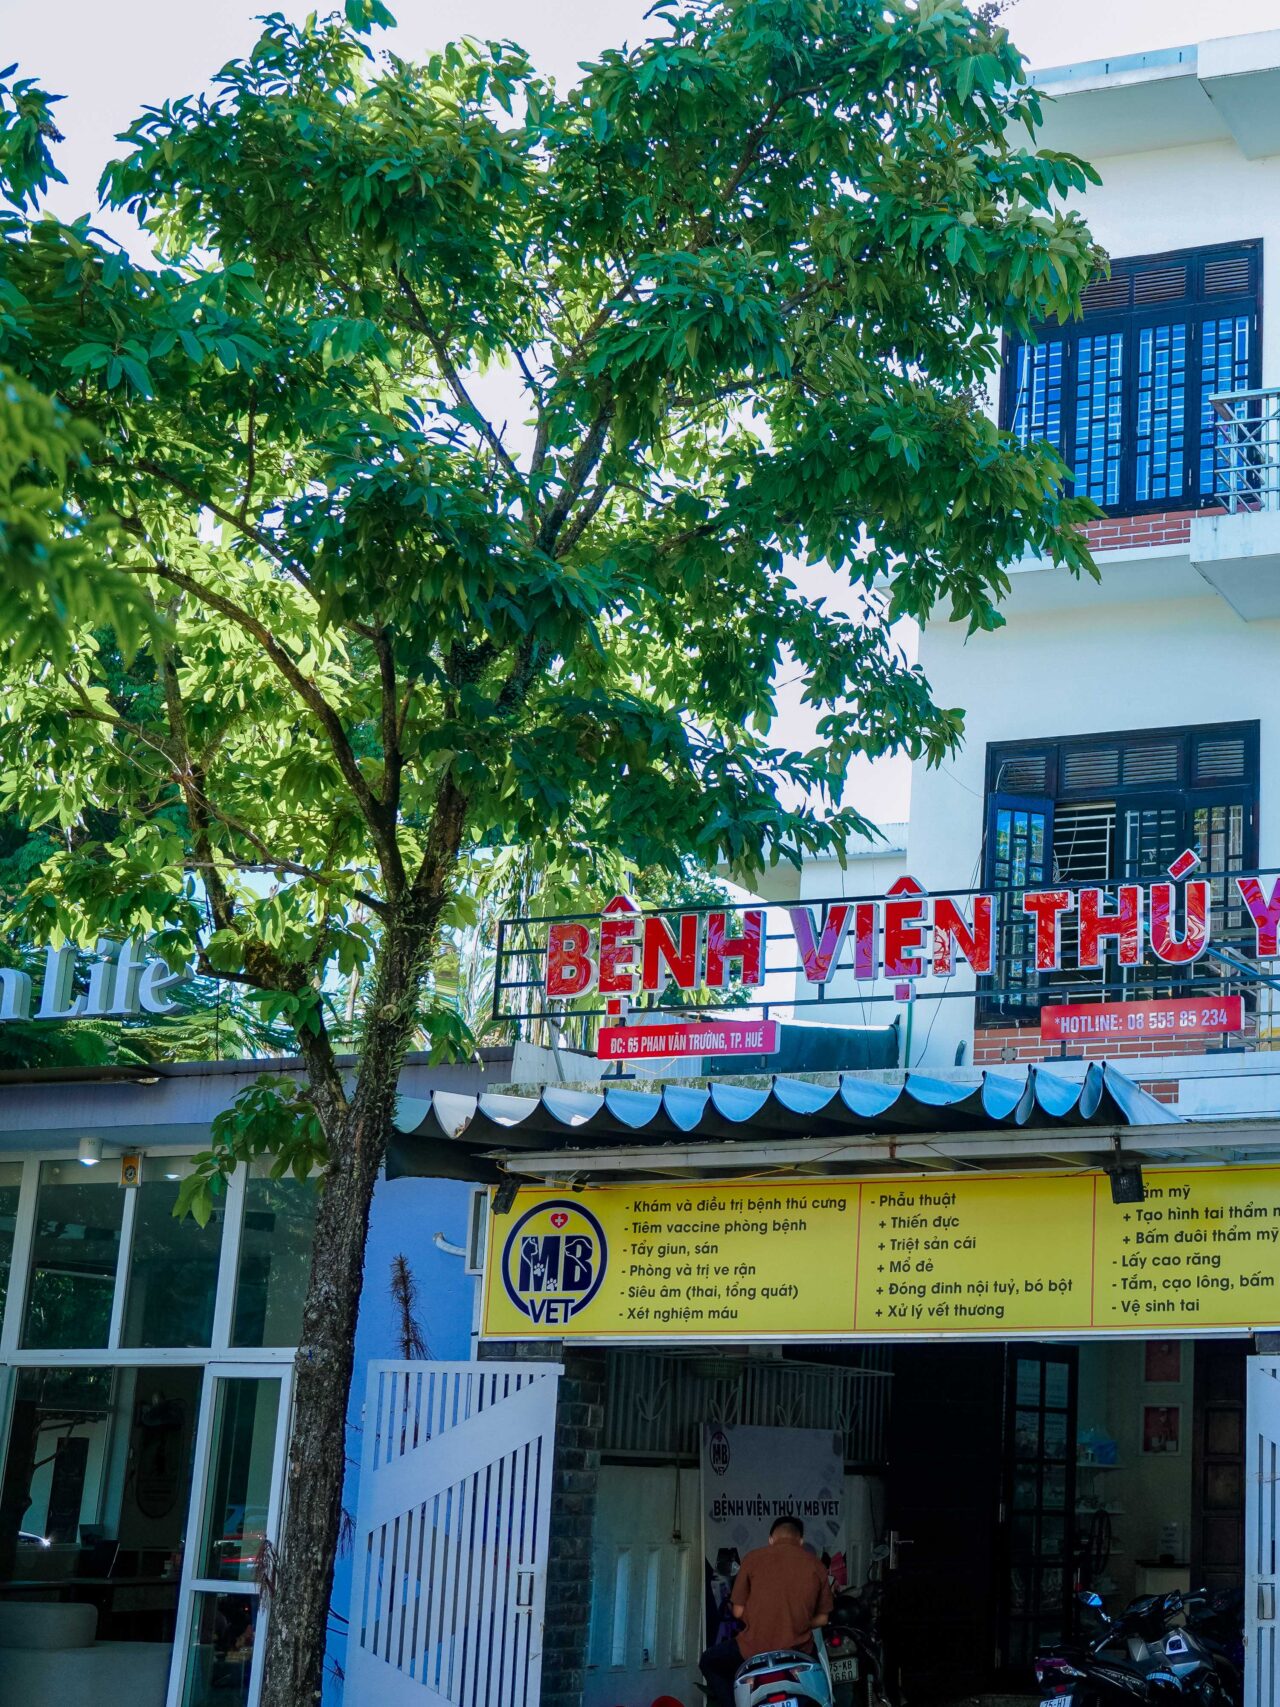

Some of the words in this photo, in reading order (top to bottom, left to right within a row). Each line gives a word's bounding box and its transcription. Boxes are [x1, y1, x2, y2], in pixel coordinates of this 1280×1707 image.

[545, 895, 767, 1017] BỆNH
[788, 875, 997, 1003] VIỆN
[1022, 848, 1211, 972] THÚ
[1127, 1013, 1145, 1030] 08
[1148, 1011, 1175, 1029] 555
[1179, 1010, 1197, 1027] 85
[1201, 1008, 1228, 1026] 234
[627, 1037, 639, 1053] 65
[640, 1035, 666, 1052] PHAN
[668, 1031, 687, 1051] VĂN
[730, 1032, 743, 1049] TP.
[745, 1025, 765, 1048] HUẾ
[879, 1191, 915, 1207] Phẫu
[918, 1191, 957, 1209] thuật
[1168, 1184, 1191, 1201] mỹ
[633, 1199, 672, 1213] Khám
[676, 1198, 693, 1212] và
[696, 1195, 726, 1212] điều
[730, 1198, 744, 1214] trị
[747, 1197, 782, 1214] bệnh
[785, 1195, 808, 1210] thú
[811, 1198, 847, 1212] cưng
[1135, 1208, 1163, 1225] Tạo
[1167, 1206, 1200, 1221] hình
[1203, 1206, 1224, 1220] tai
[1228, 1201, 1268, 1219] thẩm
[631, 1220, 662, 1234] Tiêm
[666, 1220, 721, 1234] vaccine
[724, 1219, 768, 1236] phòng
[772, 1218, 807, 1235] bệnh
[890, 1213, 928, 1229] Thiến
[932, 1215, 960, 1231] đực
[889, 1237, 920, 1253] Triệt
[923, 1236, 949, 1250] sản
[953, 1235, 977, 1250] cái
[1135, 1227, 1169, 1245] Bấm
[1174, 1228, 1208, 1243] đuôi
[1211, 1224, 1252, 1242] thẩm
[1256, 1226, 1280, 1243] mỹ
[630, 1240, 654, 1258] Tẩy
[657, 1242, 690, 1259] giun,
[694, 1241, 719, 1255] sán
[518, 1235, 593, 1292] MB
[889, 1256, 911, 1273] Mổ
[915, 1257, 934, 1273] đẻ
[1121, 1251, 1148, 1270] Lấy
[1151, 1255, 1182, 1267] cao
[1186, 1252, 1221, 1269] răng
[629, 1263, 672, 1280] Phòng
[675, 1263, 692, 1276] và
[696, 1263, 710, 1279] trị
[713, 1266, 730, 1276] ve
[733, 1262, 756, 1279] rận
[888, 1281, 927, 1298] Đóng
[930, 1281, 962, 1295] đinh
[966, 1280, 989, 1296] nội
[993, 1278, 1020, 1296] tuỷ,
[1024, 1278, 1044, 1293] bó
[1048, 1278, 1073, 1296] bột
[1120, 1273, 1157, 1292] Tắm,
[1161, 1278, 1192, 1292] cạo
[1196, 1274, 1235, 1292] lông,
[1239, 1270, 1275, 1287] bấm
[627, 1285, 656, 1298] Siêu
[659, 1284, 682, 1298] âm
[685, 1285, 721, 1301] (thai,
[725, 1281, 757, 1301] tổng
[760, 1283, 799, 1300] quát)
[528, 1298, 576, 1324] VET
[626, 1306, 650, 1320] Xét
[653, 1306, 704, 1323] nghiệm
[707, 1305, 738, 1320] máu
[887, 1302, 908, 1318] Xử
[911, 1303, 924, 1320] lý
[927, 1301, 950, 1317] vết
[953, 1303, 1005, 1319] thương
[1120, 1299, 1141, 1315] Vệ
[1145, 1299, 1175, 1313] sinh
[1179, 1298, 1200, 1312] tai
[713, 1492, 744, 1522] BỆNH
[746, 1493, 770, 1521] VIỆN
[772, 1493, 795, 1517] THÚ
[796, 1500, 802, 1516] Y
[804, 1500, 820, 1516] MB
[822, 1500, 840, 1516] VET
